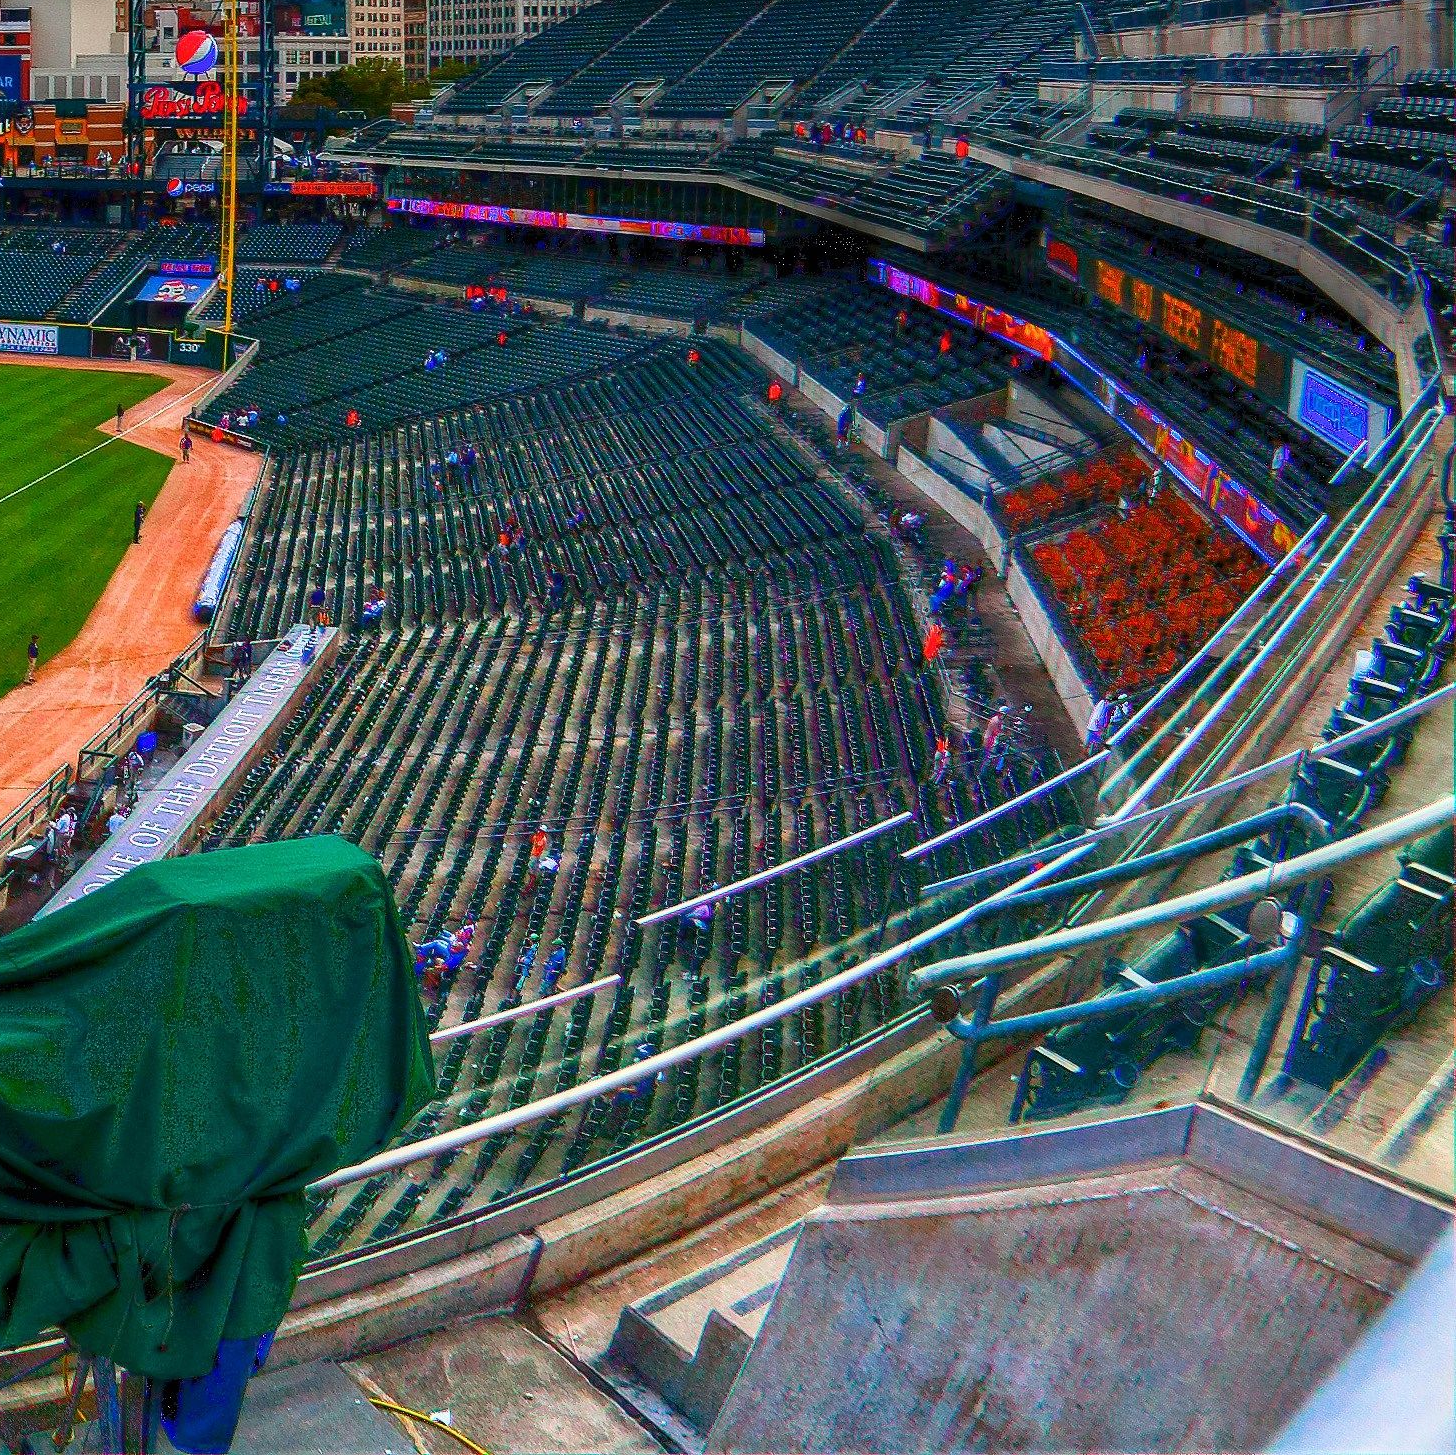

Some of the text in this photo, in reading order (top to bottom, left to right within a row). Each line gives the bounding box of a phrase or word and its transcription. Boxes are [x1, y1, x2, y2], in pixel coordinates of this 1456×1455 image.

[184, 182, 216, 194] pepsi
[66, 853, 145, 904] OME
[128, 820, 171, 849] OF
[152, 778, 206, 817] THE
[183, 707, 264, 780] DETROIT
[241, 660, 302, 707] TIGERS
